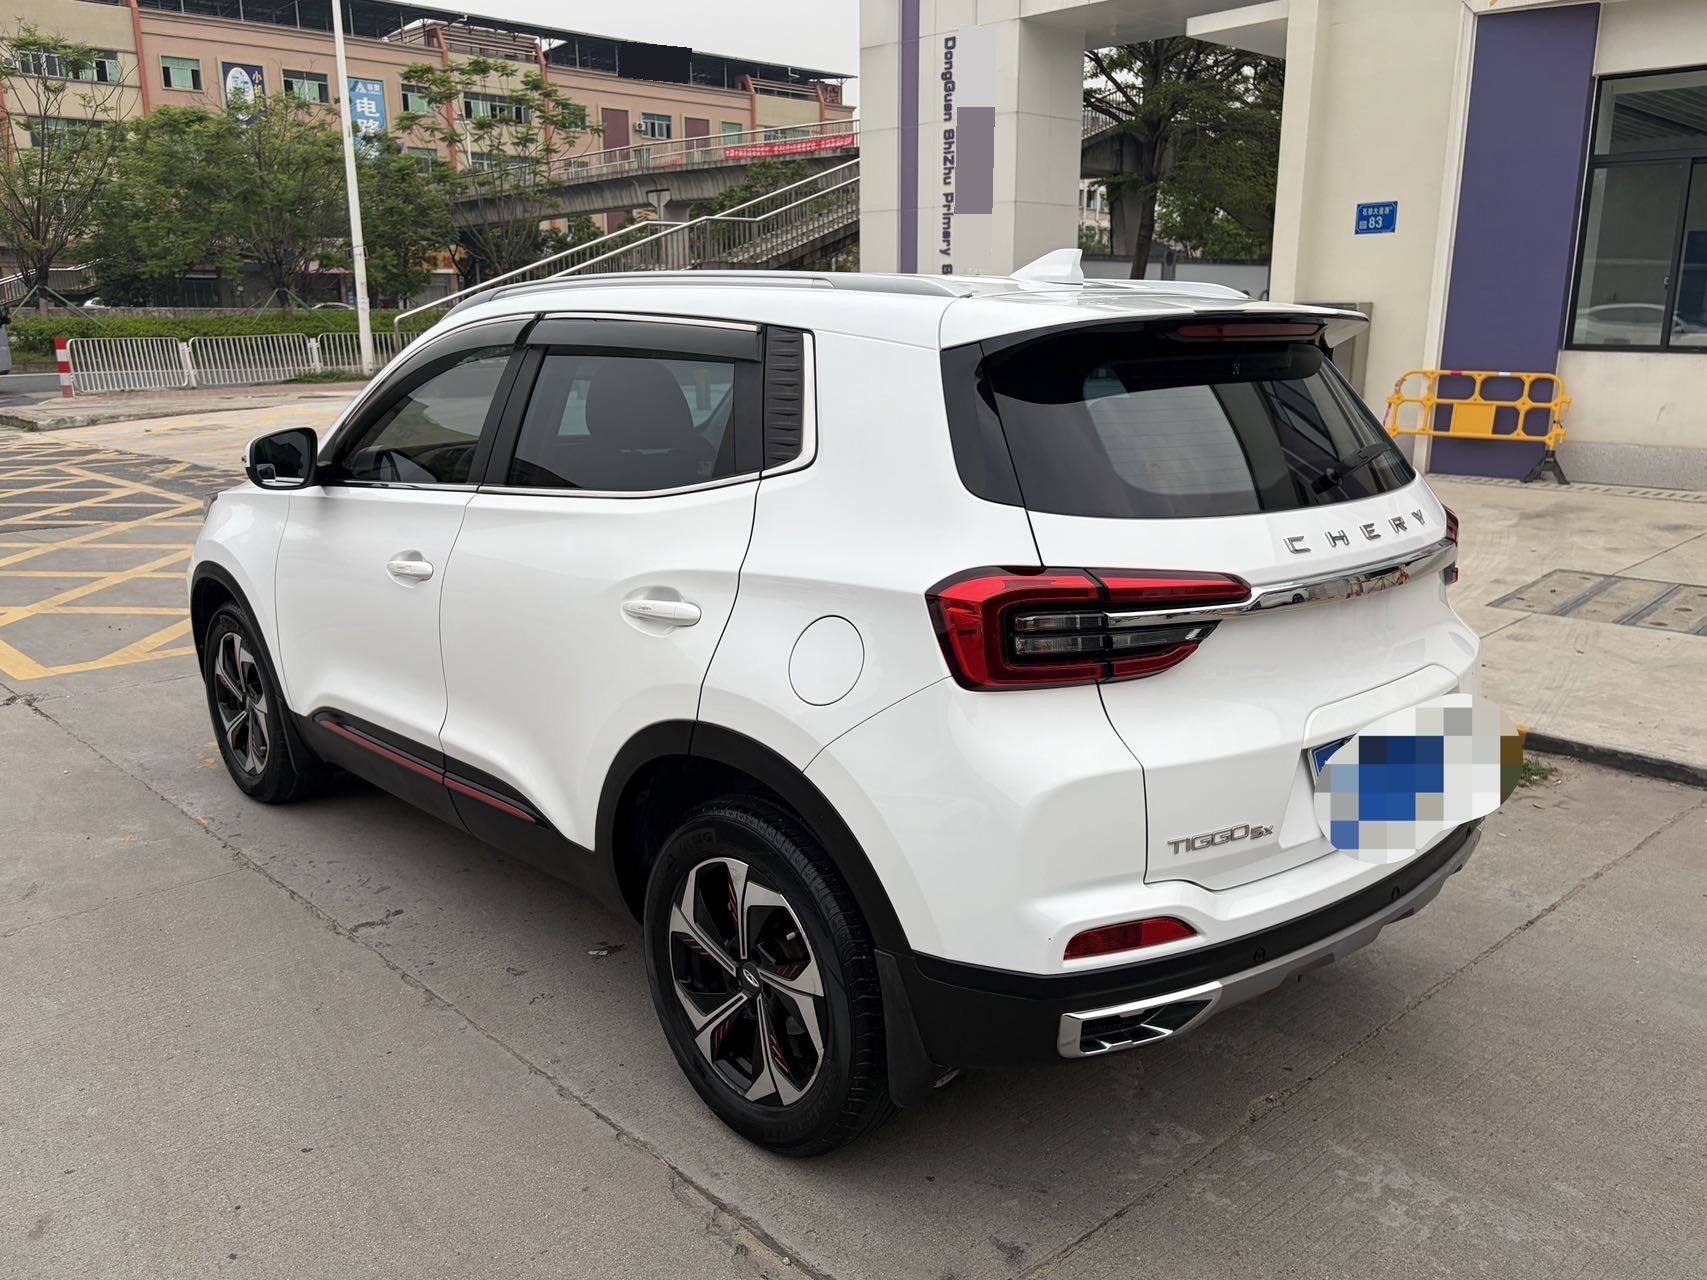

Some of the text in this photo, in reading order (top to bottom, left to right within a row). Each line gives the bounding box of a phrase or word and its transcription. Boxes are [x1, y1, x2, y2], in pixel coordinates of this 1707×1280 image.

[941, 36, 956, 122] DongGuan
[943, 128, 955, 186] ShiZhu
[939, 192, 954, 256] Primary
[1368, 215, 1383, 229] 83
[1283, 508, 1426, 554] CHERY
